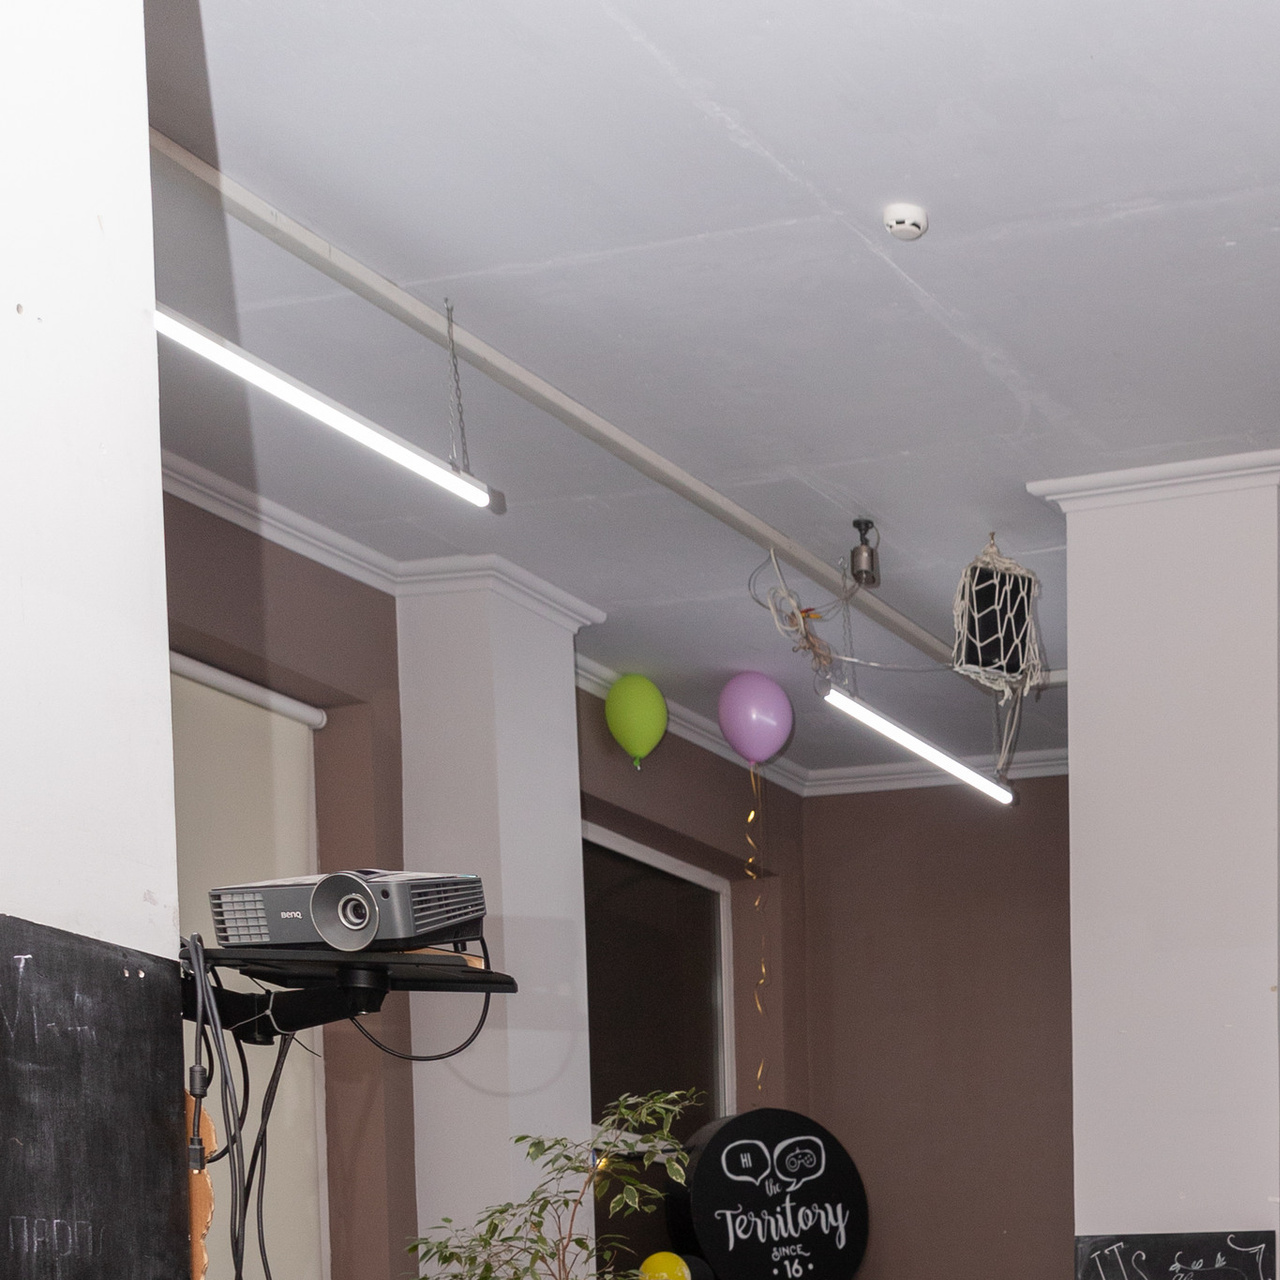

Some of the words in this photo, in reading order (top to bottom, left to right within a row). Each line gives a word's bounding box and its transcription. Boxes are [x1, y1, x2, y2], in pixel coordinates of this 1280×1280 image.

[280, 911, 303, 920] BenQ
[740, 1152, 753, 1169] HI
[764, 1177, 782, 1198] the
[714, 1193, 850, 1252] Territory
[771, 1243, 811, 1262] SINCE
